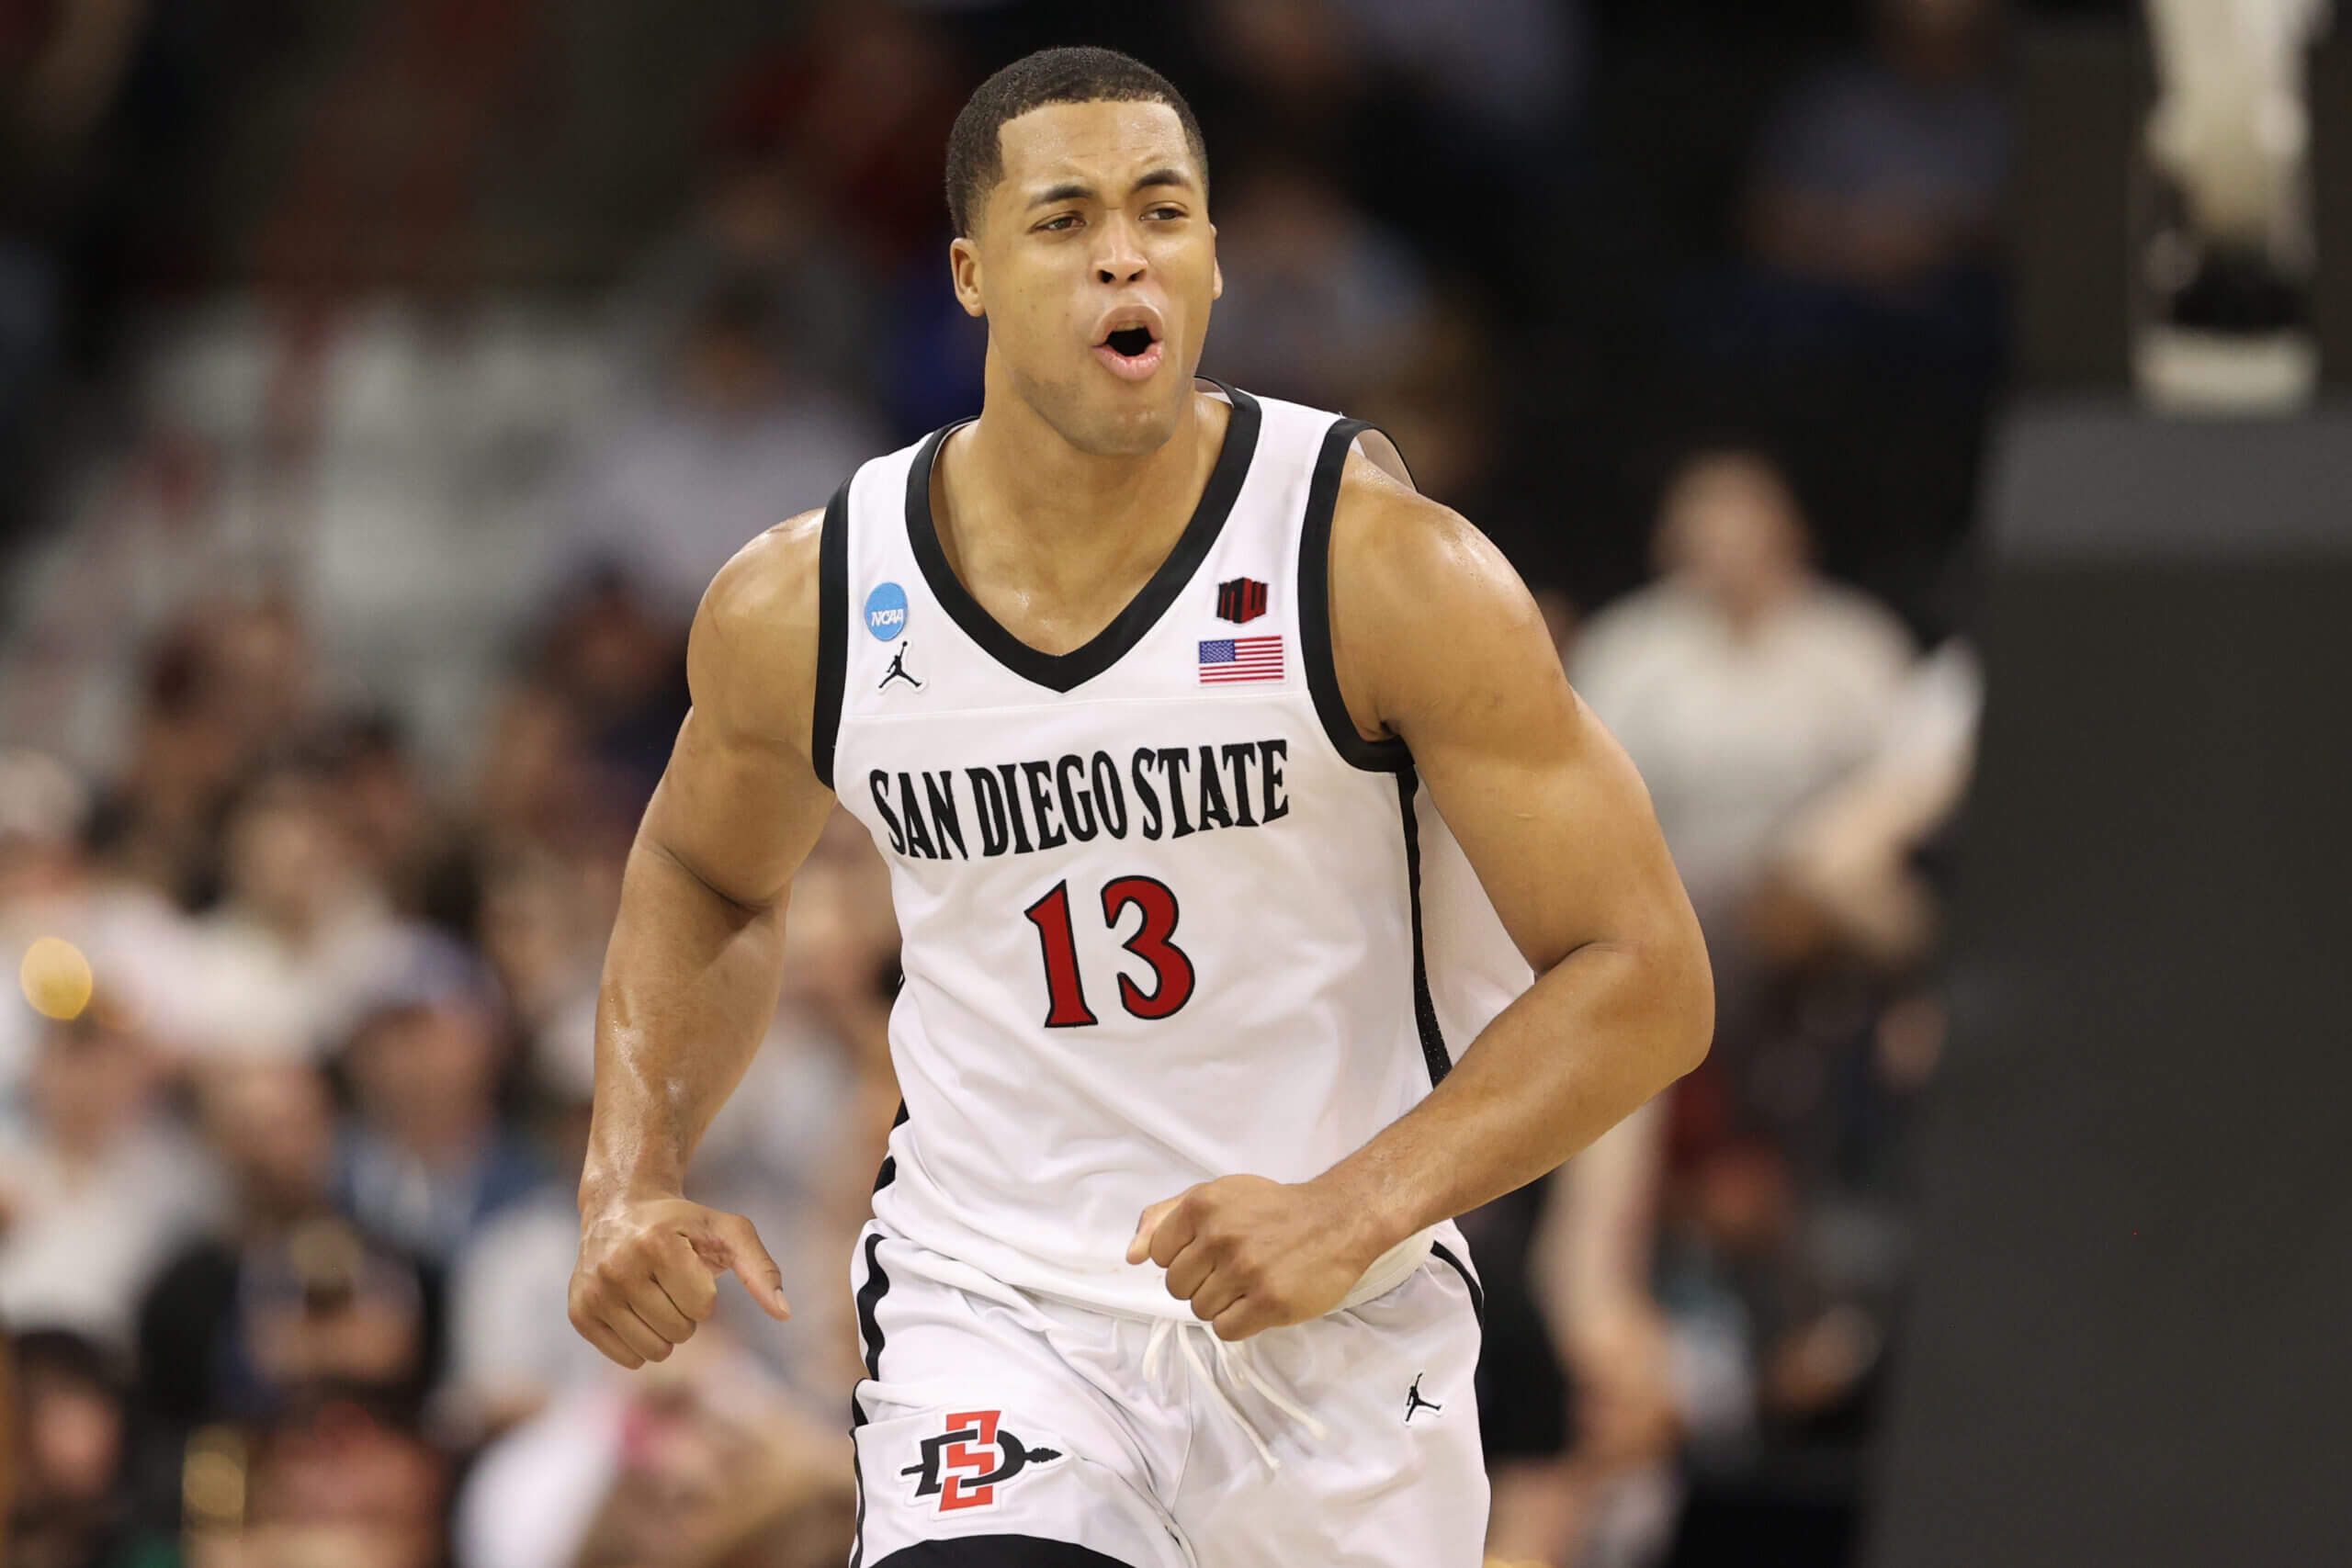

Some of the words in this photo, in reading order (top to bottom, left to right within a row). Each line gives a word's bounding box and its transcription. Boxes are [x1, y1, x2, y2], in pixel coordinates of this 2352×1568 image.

[871, 608, 904, 626] NCAA
[869, 770, 968, 860] SAN
[966, 750, 1127, 857] DIEGO
[1131, 739, 1289, 840] STATE
[1023, 875, 1195, 1028] 13
